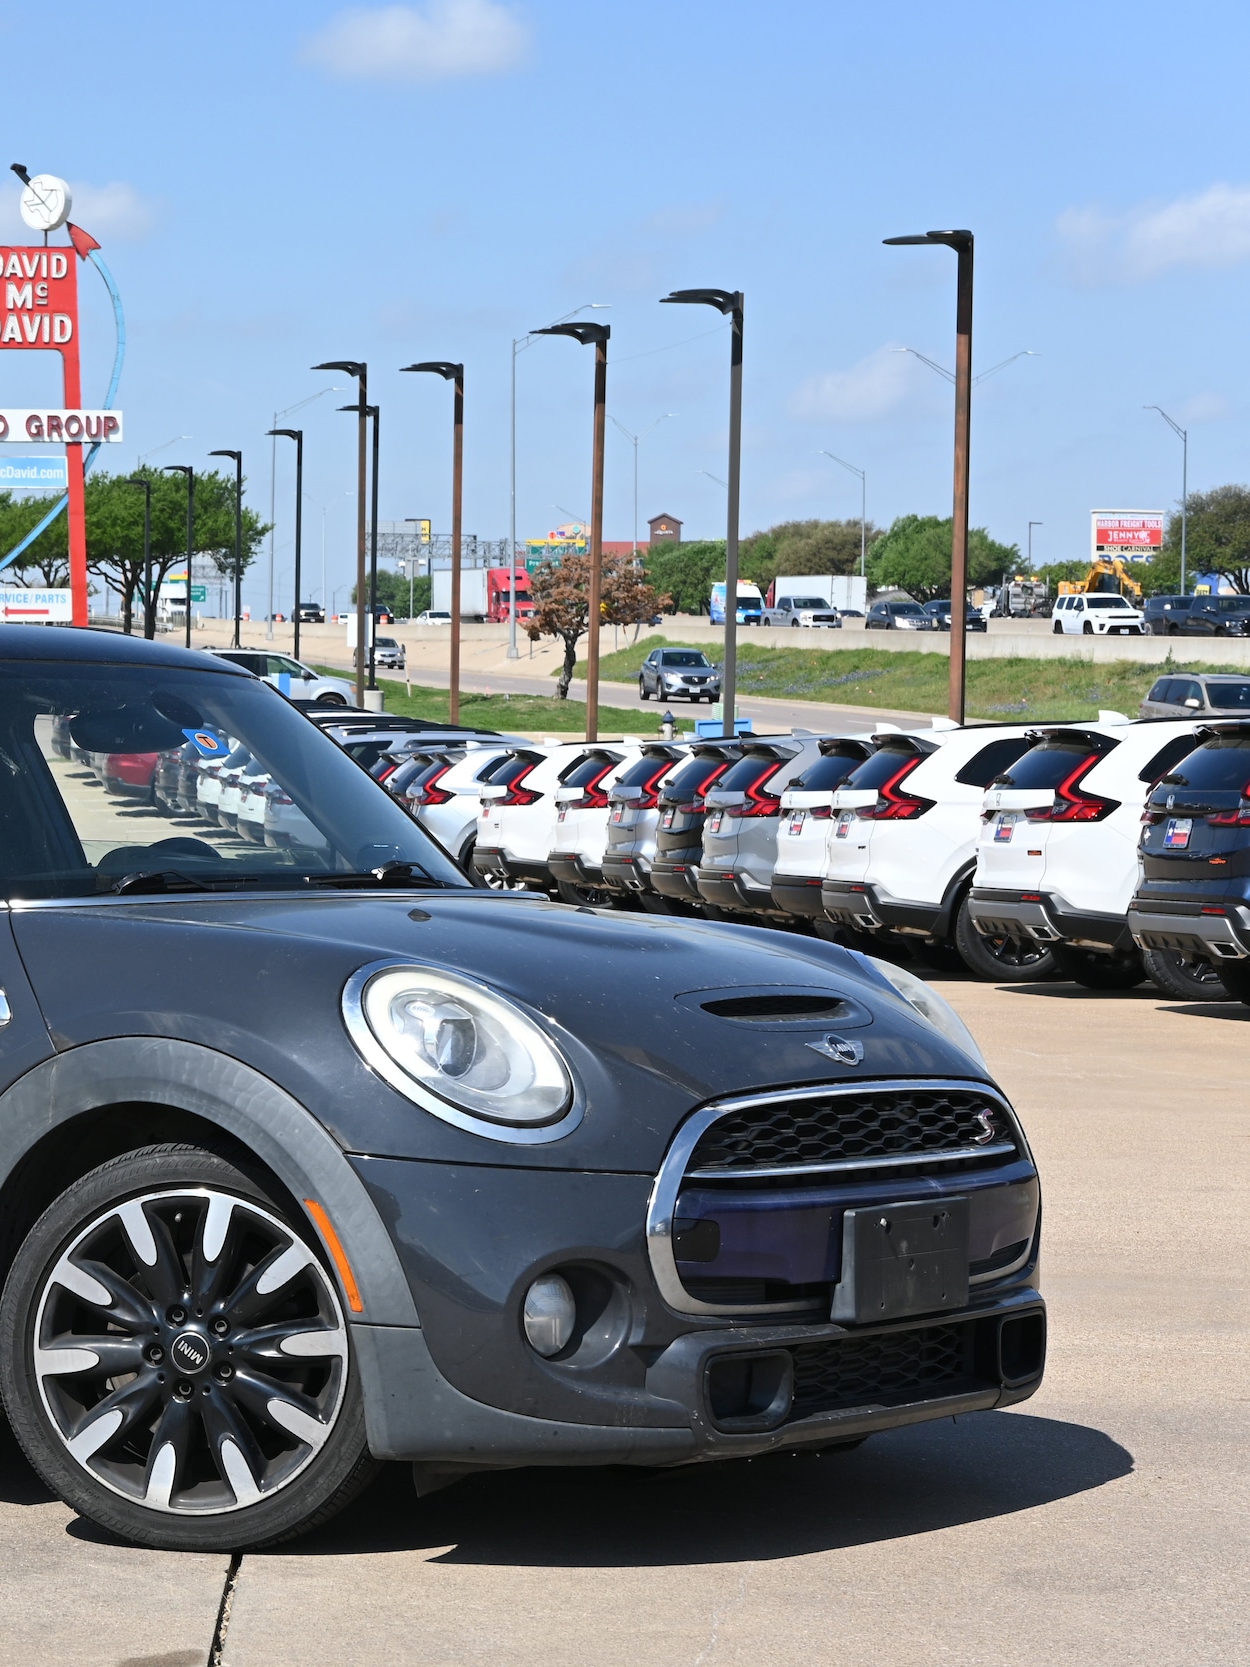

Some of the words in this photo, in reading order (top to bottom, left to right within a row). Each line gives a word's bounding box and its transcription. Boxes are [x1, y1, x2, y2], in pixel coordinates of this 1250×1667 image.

[6, 281, 48, 309] Mc
[25, 414, 119, 439] GROUP
[1120, 520, 1143, 529] FREIGHT
[1144, 520, 1162, 529] TOOLS
[177, 1340, 204, 1365] MINI
